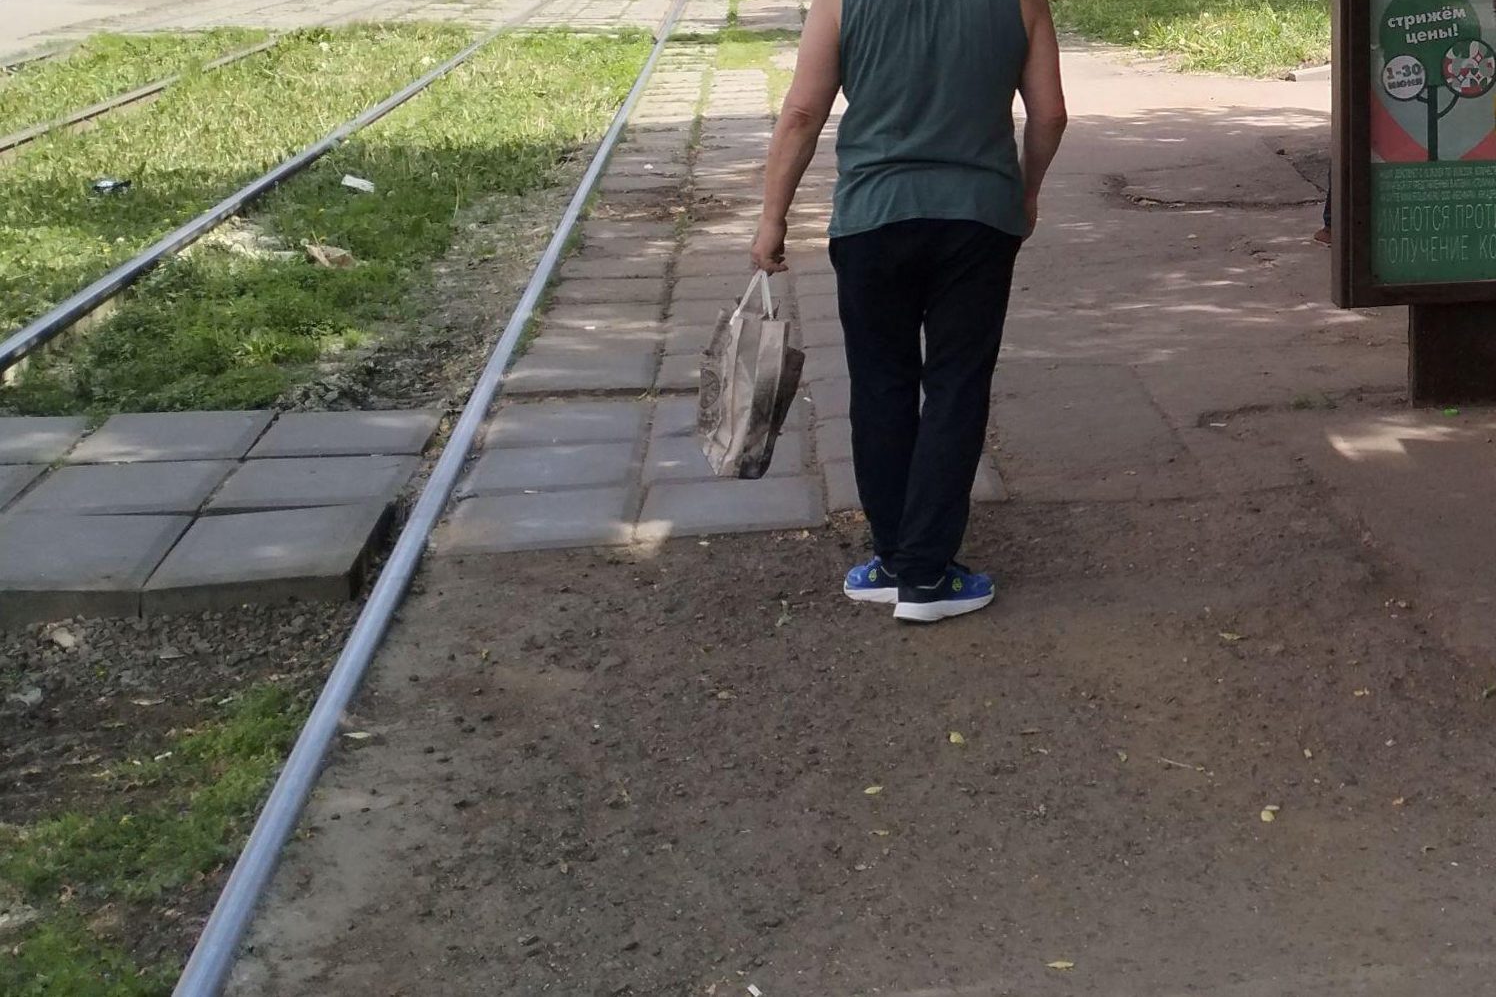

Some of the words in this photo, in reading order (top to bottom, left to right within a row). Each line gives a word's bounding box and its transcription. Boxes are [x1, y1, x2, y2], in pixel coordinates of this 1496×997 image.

[1387, 6, 1467, 30] стрижём
[1405, 23, 1459, 44] цены!
[1385, 63, 1424, 80] 1-30
[1378, 205, 1450, 234] ИМЕЮТСЯ
[1378, 234, 1470, 265] ПОЛУЧЕНИЕ
